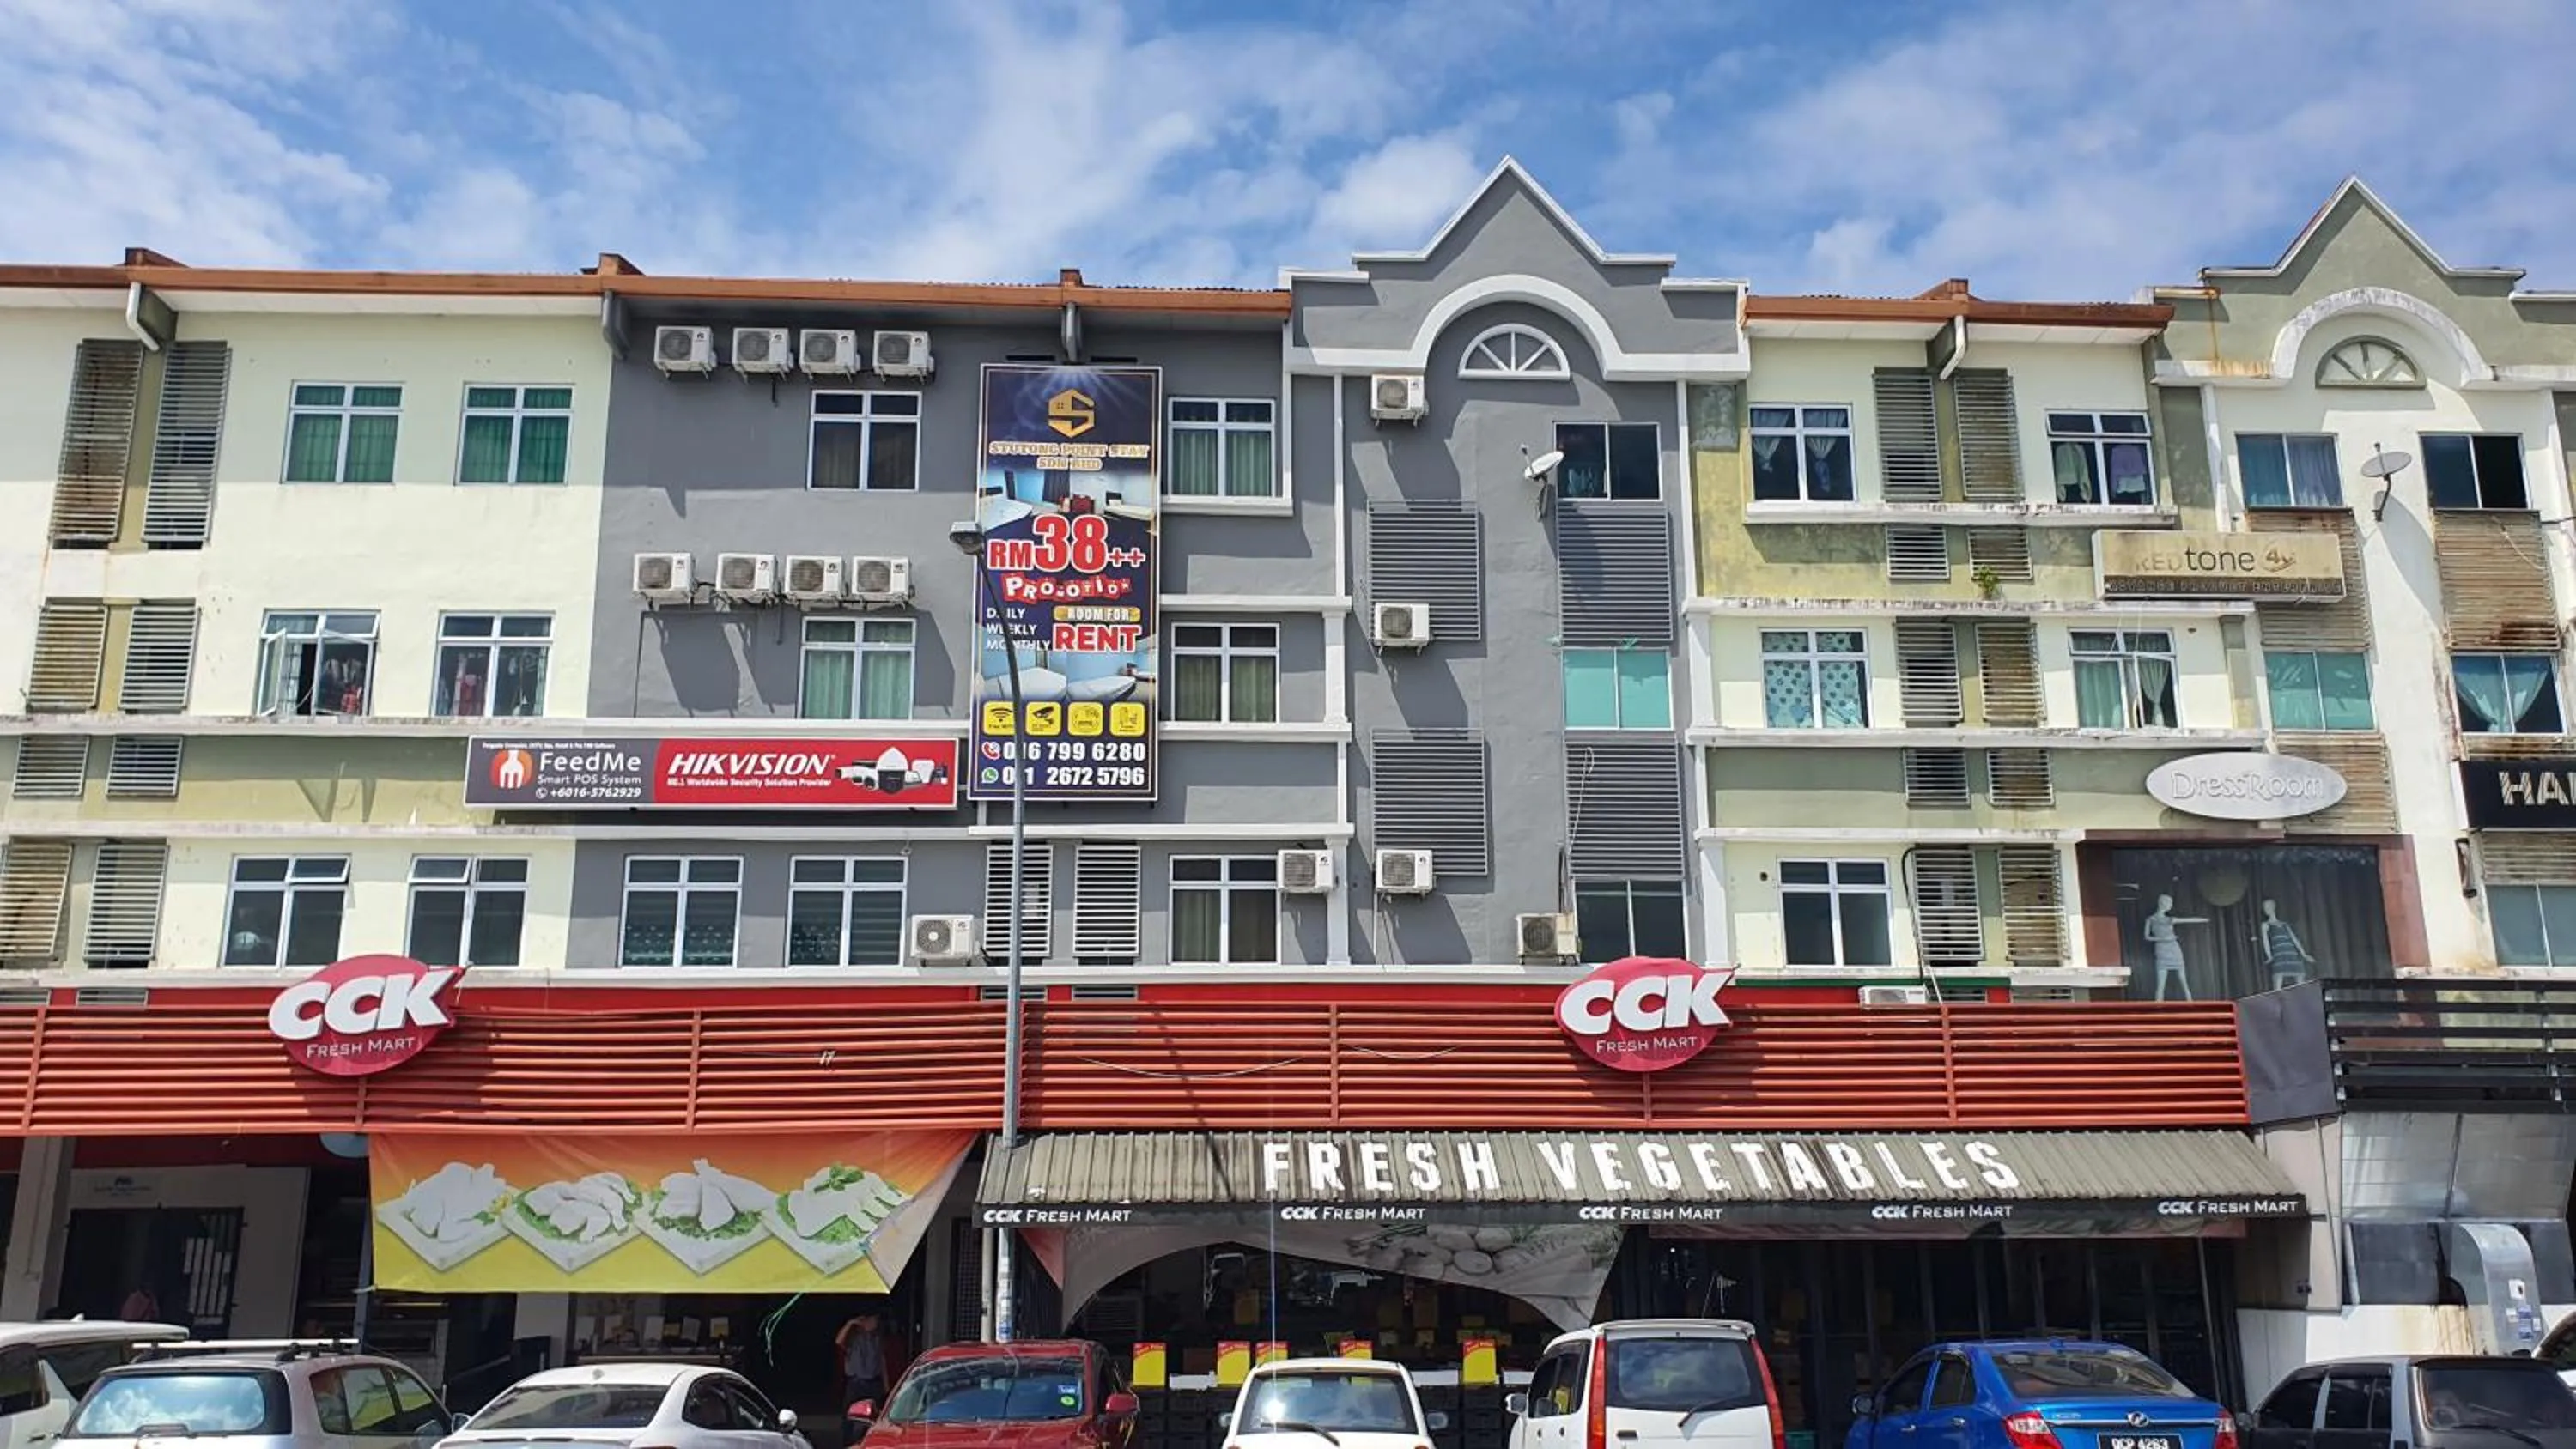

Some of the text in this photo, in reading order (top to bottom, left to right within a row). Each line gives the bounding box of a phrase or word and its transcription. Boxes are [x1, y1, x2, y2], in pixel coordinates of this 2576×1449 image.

[1061, 443, 1108, 458] POINT
[987, 607, 1025, 619] DILY
[1067, 607, 1130, 621] ROOM FOR
[1053, 624, 1141, 653] RENT
[1047, 743, 1085, 761] 799
[1091, 743, 1146, 761] 6280
[539, 751, 641, 772] FeedMe
[667, 753, 832, 776] HIKVISION
[538, 774, 642, 787] Smart POS System
[1002, 766, 1145, 786] 01 2672 5796
[268, 969, 456, 1040] CCK
[1559, 972, 1733, 1035] CCK
[307, 1036, 416, 1058] FRESH MART
[1596, 1035, 1698, 1054] FRESH MART
[1262, 1139, 2020, 1191] FRESH VEGETABLES
[983, 1210, 1132, 1223] CCK FRESH MART
[1281, 1206, 1425, 1220] CCK FRESH MART
[1580, 1206, 1723, 1220] CCK FRESH MART
[1872, 1204, 2013, 1219] CCK FRESH MART
[2158, 1200, 2298, 1215] CCK FRESH MART
